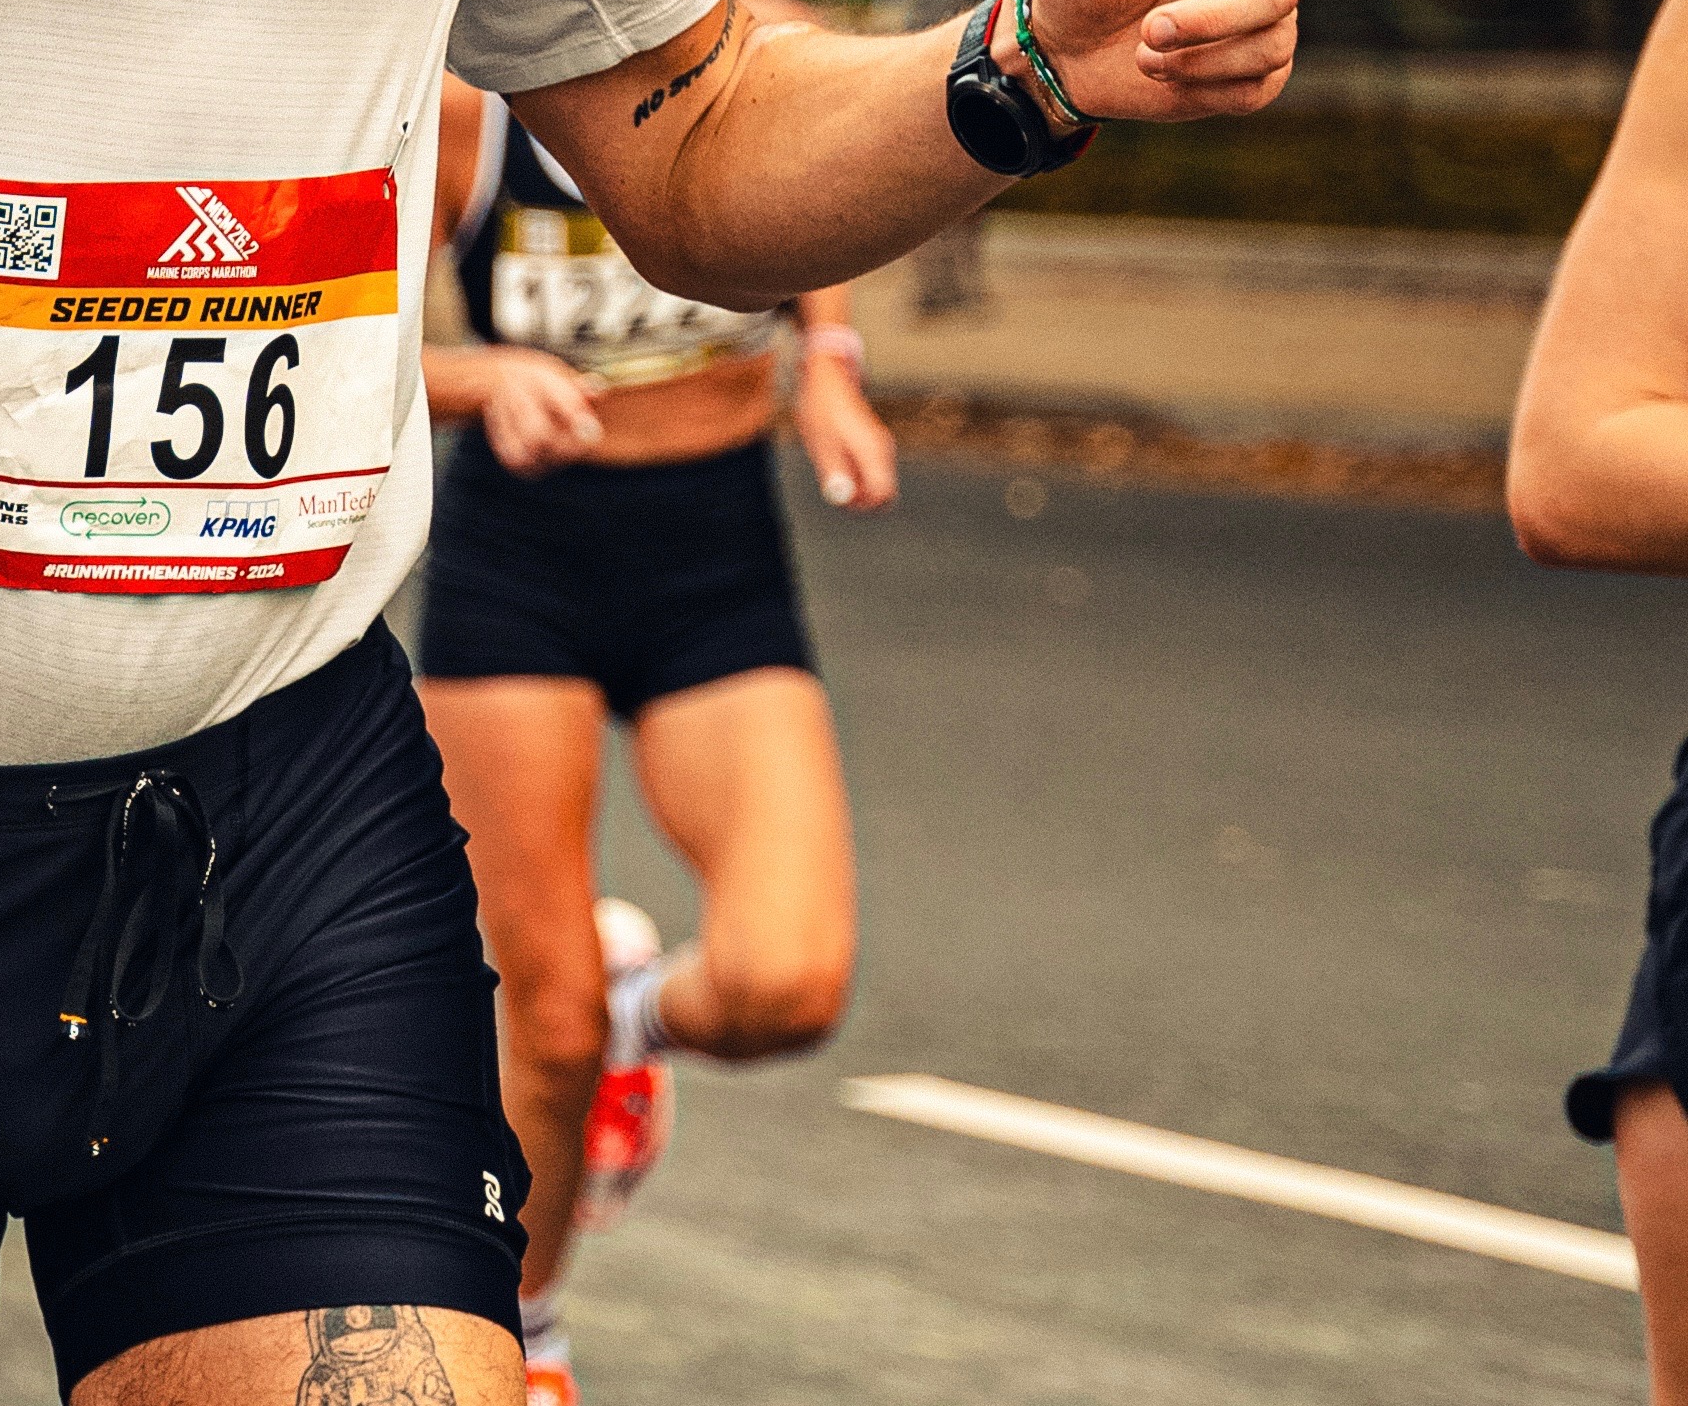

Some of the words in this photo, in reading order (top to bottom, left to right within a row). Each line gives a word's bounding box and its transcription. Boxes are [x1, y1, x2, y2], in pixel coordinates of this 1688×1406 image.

[147, 266, 180, 279] MARINE
[181, 266, 210, 279] CORPS
[212, 265, 257, 279] MARATHON
[49, 297, 191, 322] SEEDED
[200, 291, 323, 322] RUNNER
[65, 333, 300, 480] 156
[72, 509, 160, 525] recover
[199, 515, 276, 538] KPMG
[43, 564, 238, 581] #RUNWITHTHEMARINES
[246, 563, 285, 579] 2024
